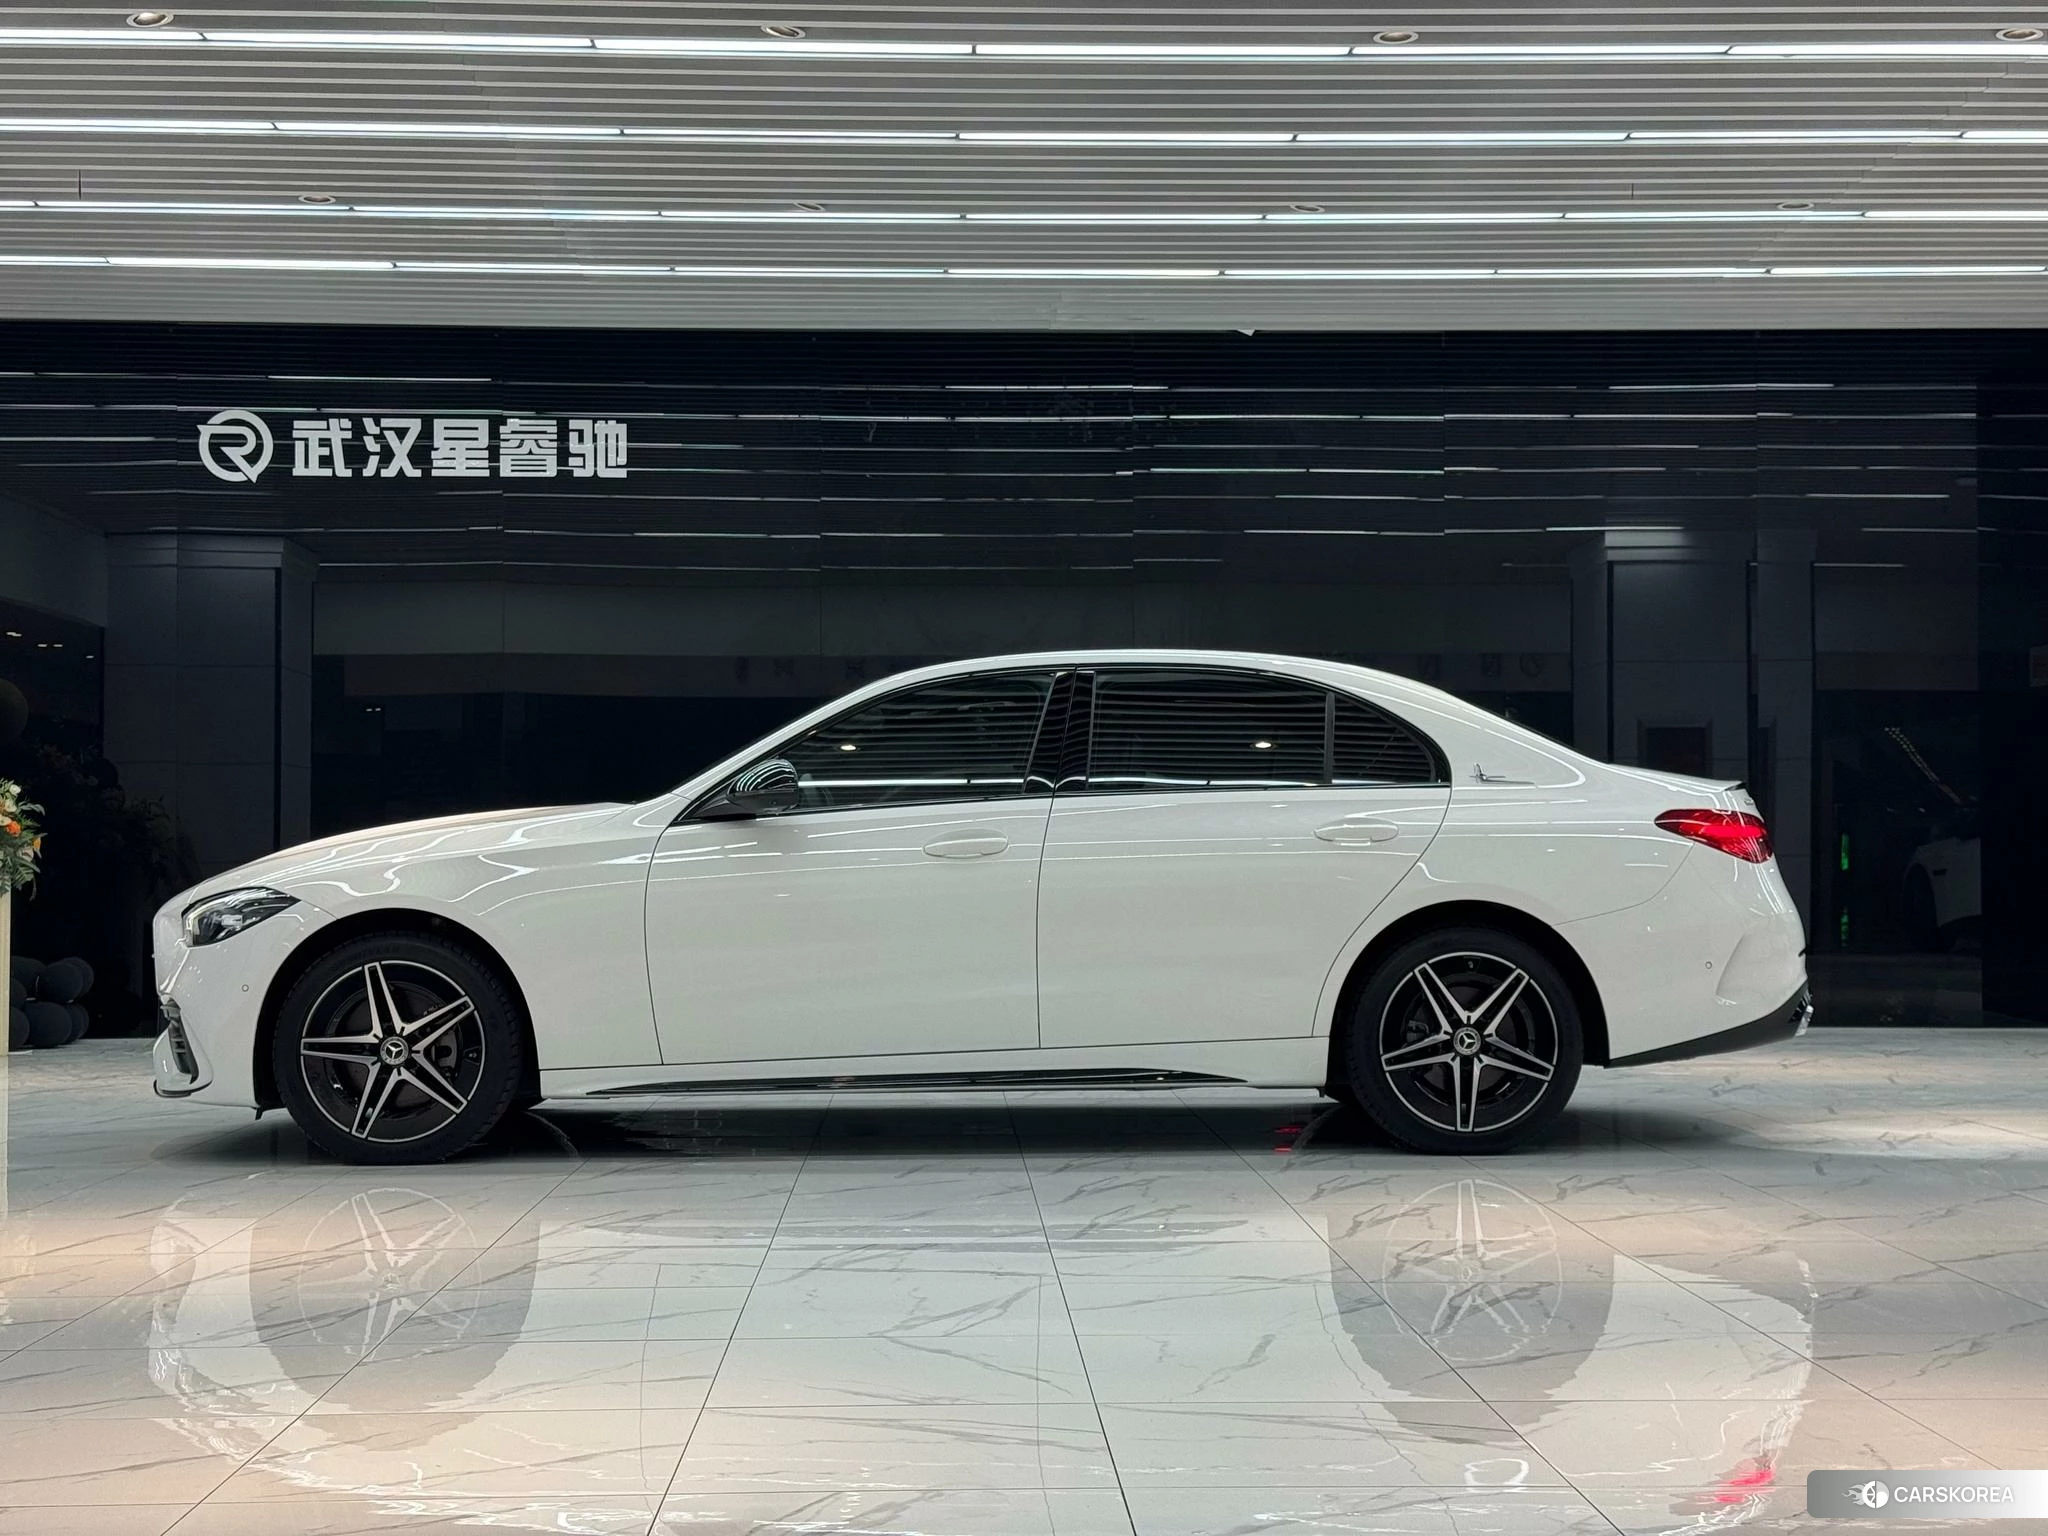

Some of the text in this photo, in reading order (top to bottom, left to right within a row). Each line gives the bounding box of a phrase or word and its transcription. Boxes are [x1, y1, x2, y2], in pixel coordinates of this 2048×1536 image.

[292, 418, 628, 478] 武汉星睿驰
